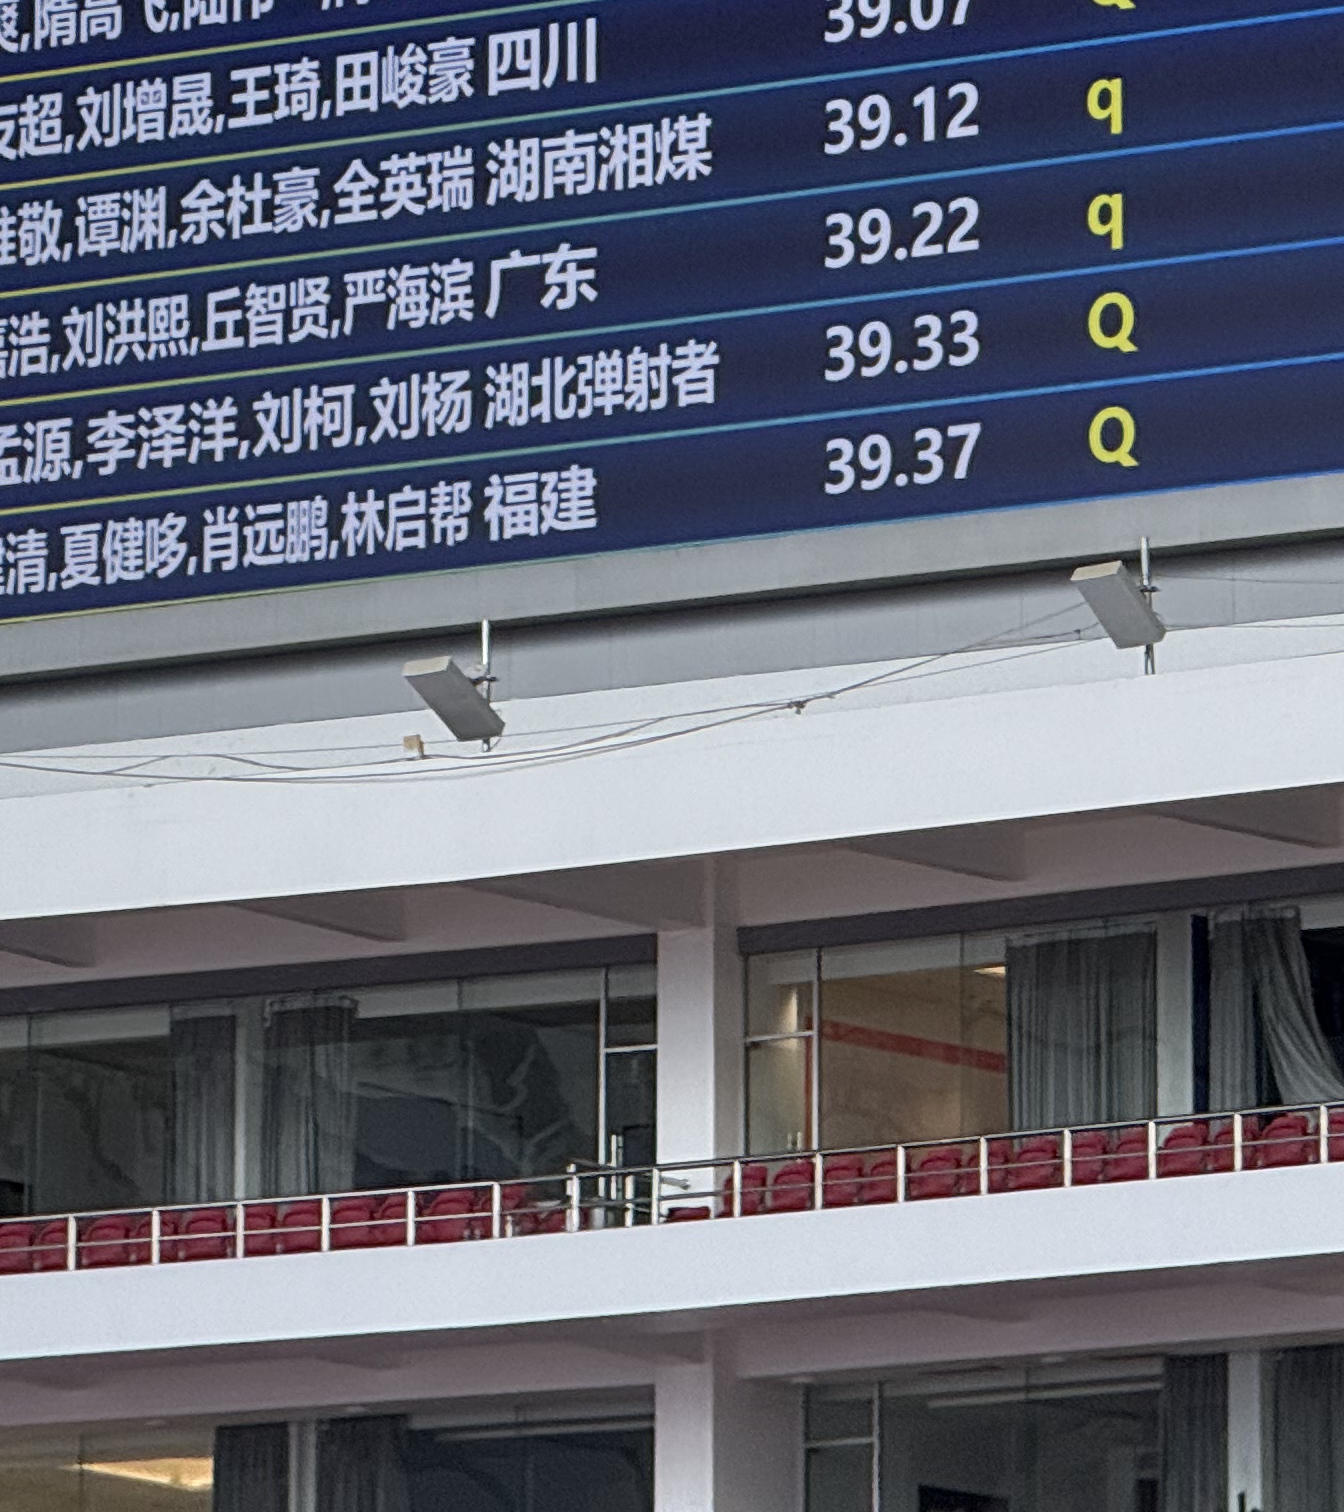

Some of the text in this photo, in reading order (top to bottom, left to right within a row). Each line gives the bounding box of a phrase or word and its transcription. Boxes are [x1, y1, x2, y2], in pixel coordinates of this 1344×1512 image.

[489, 18, 595, 95] 四川
[487, 113, 711, 205] 湖南湘煤
[825, 83, 978, 154] 39.12
[1088, 79, 1121, 133] q
[486, 244, 597, 317] 广东
[825, 197, 979, 268] 39.22
[1088, 194, 1122, 249] q
[485, 340, 719, 428] 湖北弹射者
[825, 311, 979, 380] 39.33
[1089, 293, 1135, 351] Q
[484, 465, 596, 540] 福建
[825, 423, 980, 493] 39.37
[1090, 407, 1137, 466] Q
